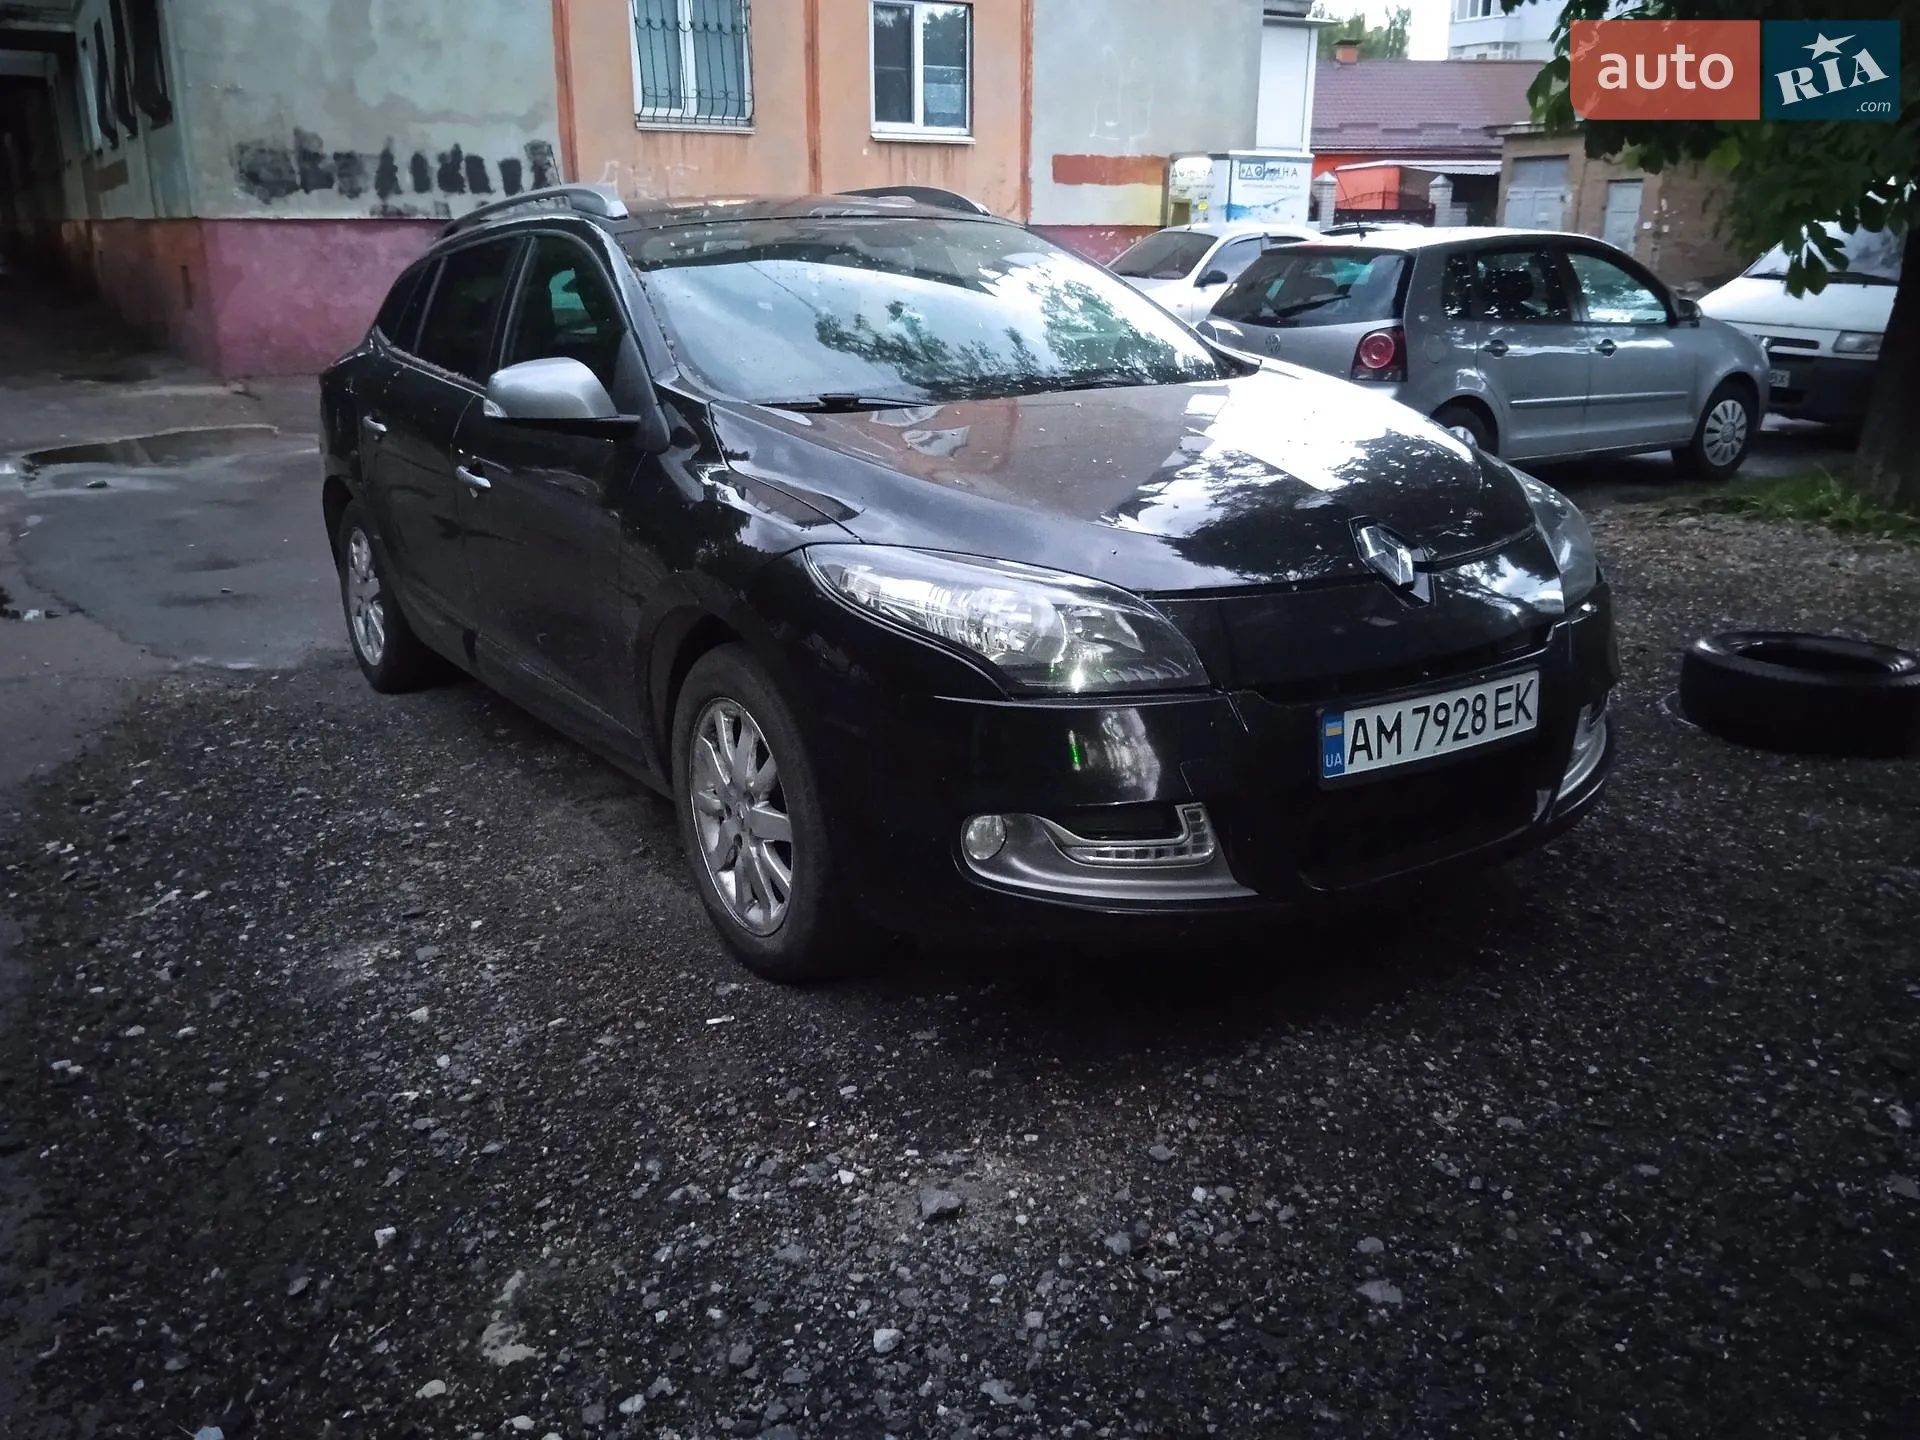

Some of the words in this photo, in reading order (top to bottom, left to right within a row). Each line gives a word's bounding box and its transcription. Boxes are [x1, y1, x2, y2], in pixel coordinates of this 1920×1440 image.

[1348, 711, 1402, 765] AM
[1411, 693, 1487, 751] 7928
[1494, 679, 1535, 731] EK
[1325, 753, 1343, 768] UA
